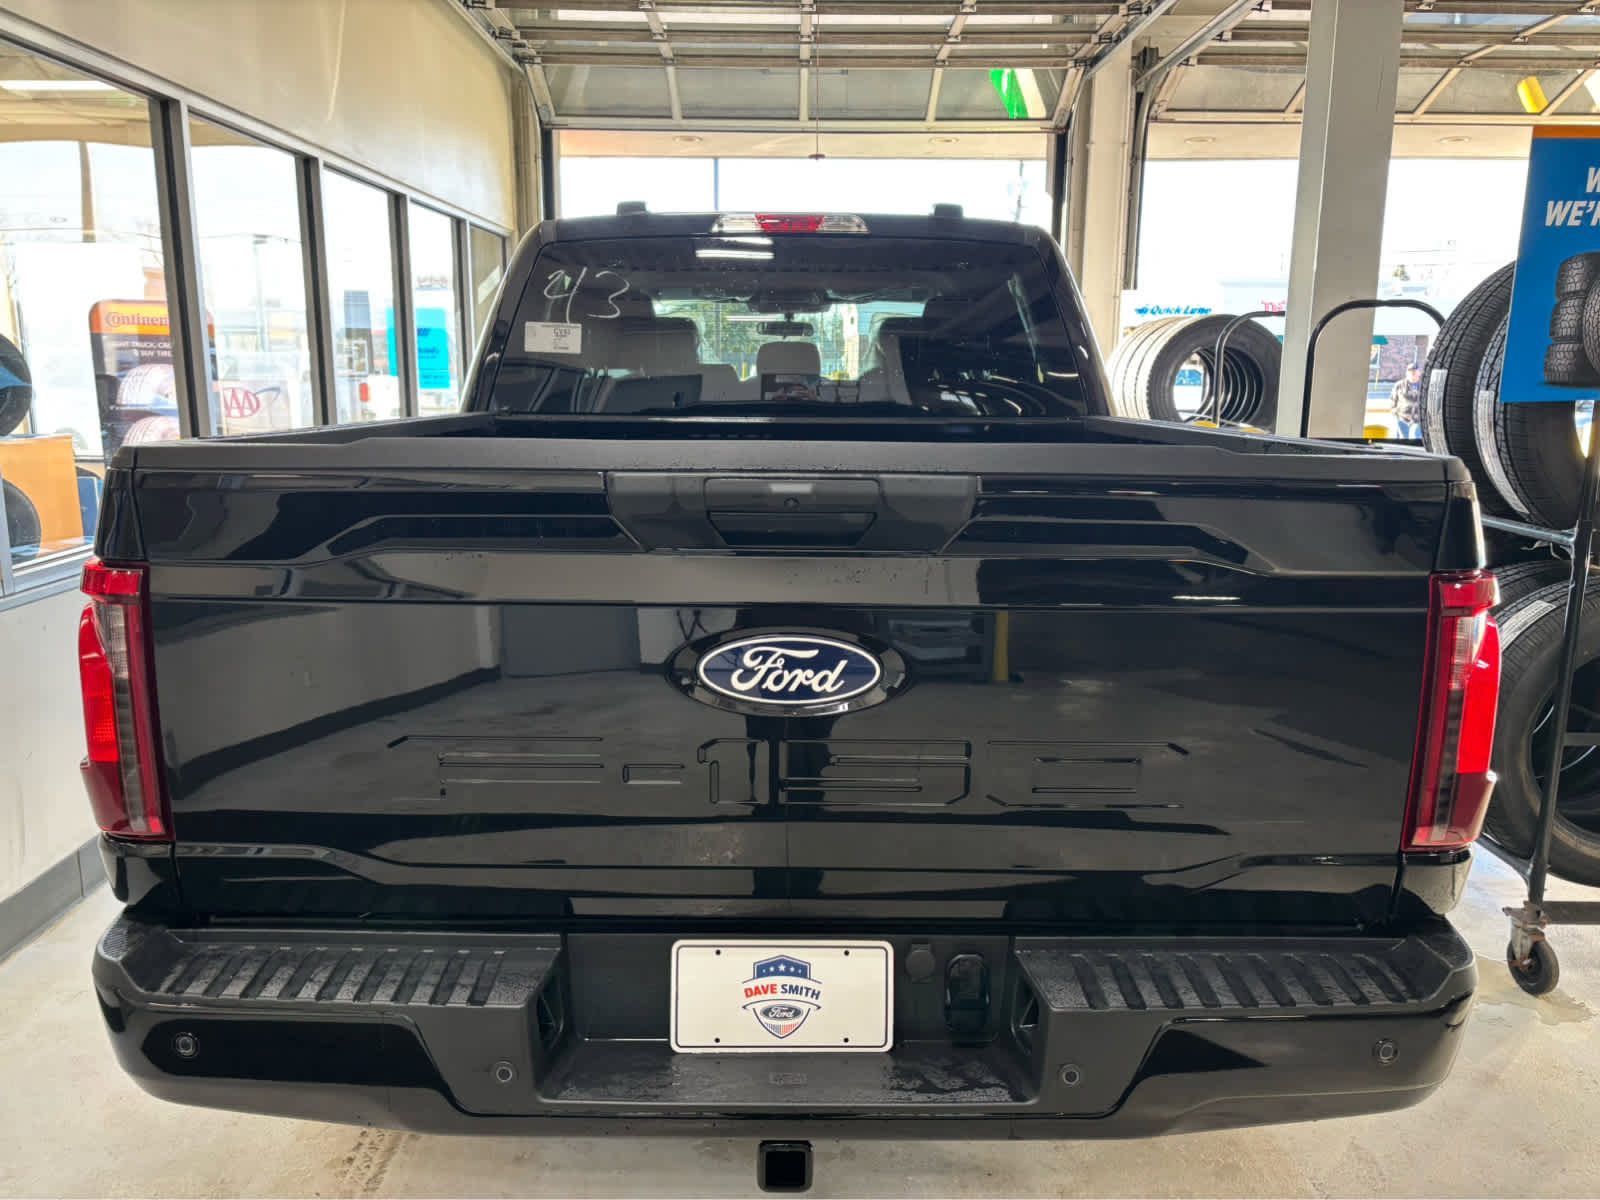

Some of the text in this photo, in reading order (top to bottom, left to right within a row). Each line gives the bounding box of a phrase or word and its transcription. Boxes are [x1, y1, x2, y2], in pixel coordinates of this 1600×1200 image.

[1150, 305, 1181, 315] Quick
[731, 646, 848, 693] Ford
[387, 735, 1190, 809] F-150
[744, 984, 821, 1001] DAVE SMITH
[768, 1006, 796, 1018] Ford
